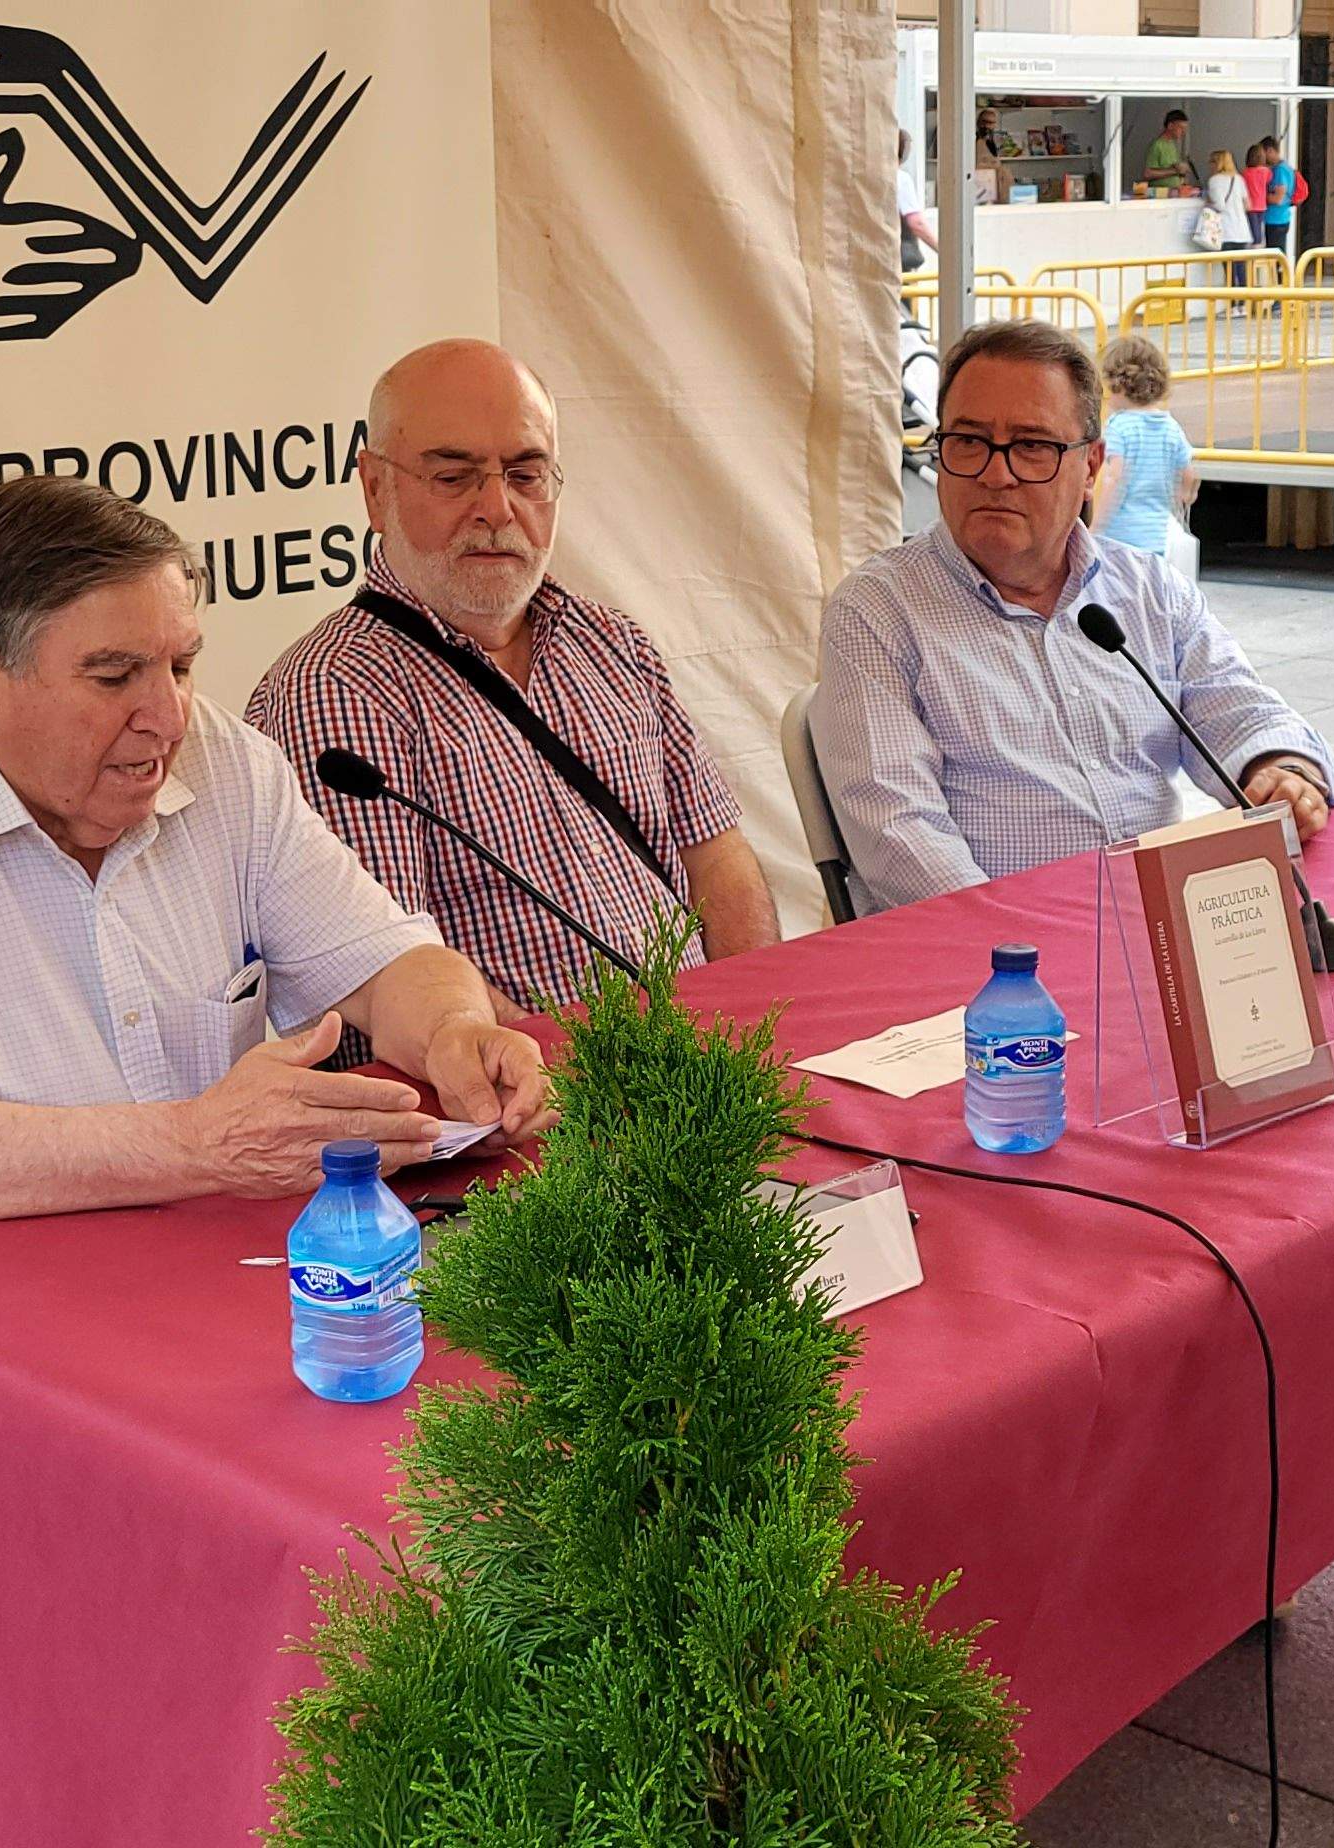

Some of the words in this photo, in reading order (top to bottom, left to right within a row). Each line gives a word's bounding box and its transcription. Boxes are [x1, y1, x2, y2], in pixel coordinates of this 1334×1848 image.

[184, 524, 375, 605] HUES
[1197, 884, 1270, 914] AGRICULTURA
[1211, 906, 1263, 930] PRÁCTICA
[1156, 920, 1169, 949] LITERA
[1161, 950, 1171, 961] LA
[1163, 963, 1173, 974] DE
[1166, 975, 1181, 1014] CARTILLA
[1174, 1015, 1183, 1026] LA
[1020, 1039, 1049, 1048] MONTE
[1023, 1045, 1049, 1054] PINOS
[306, 1266, 338, 1279] MONTE
[310, 1273, 338, 1287] PINOS
